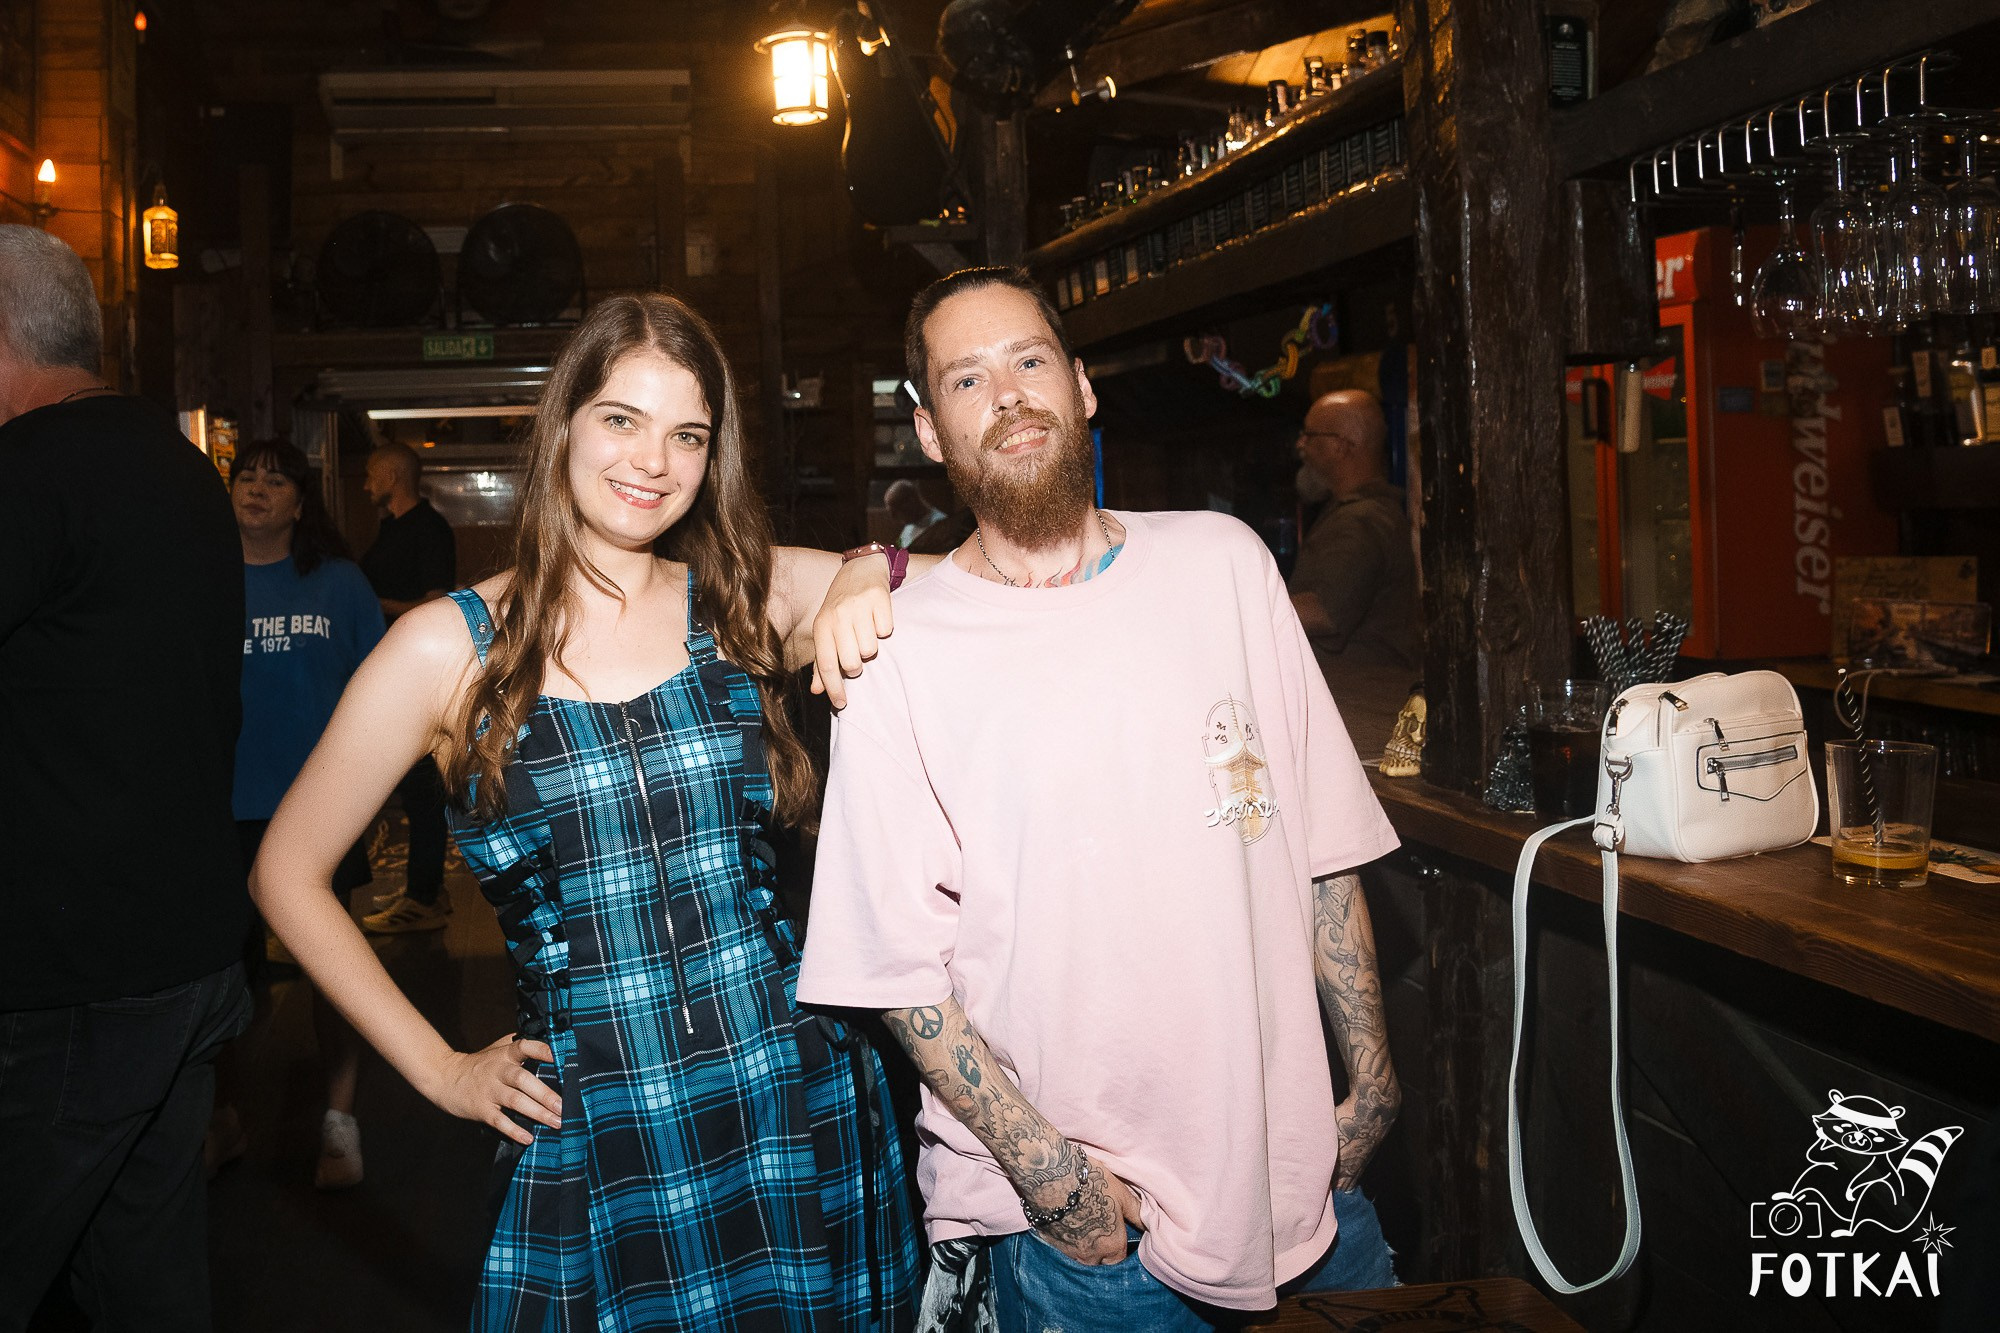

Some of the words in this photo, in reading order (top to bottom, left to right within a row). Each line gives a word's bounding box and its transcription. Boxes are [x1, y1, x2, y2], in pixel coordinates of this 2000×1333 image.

[252, 616, 285, 637] THE
[290, 615, 331, 639] BEAT
[260, 636, 291, 653] 1972
